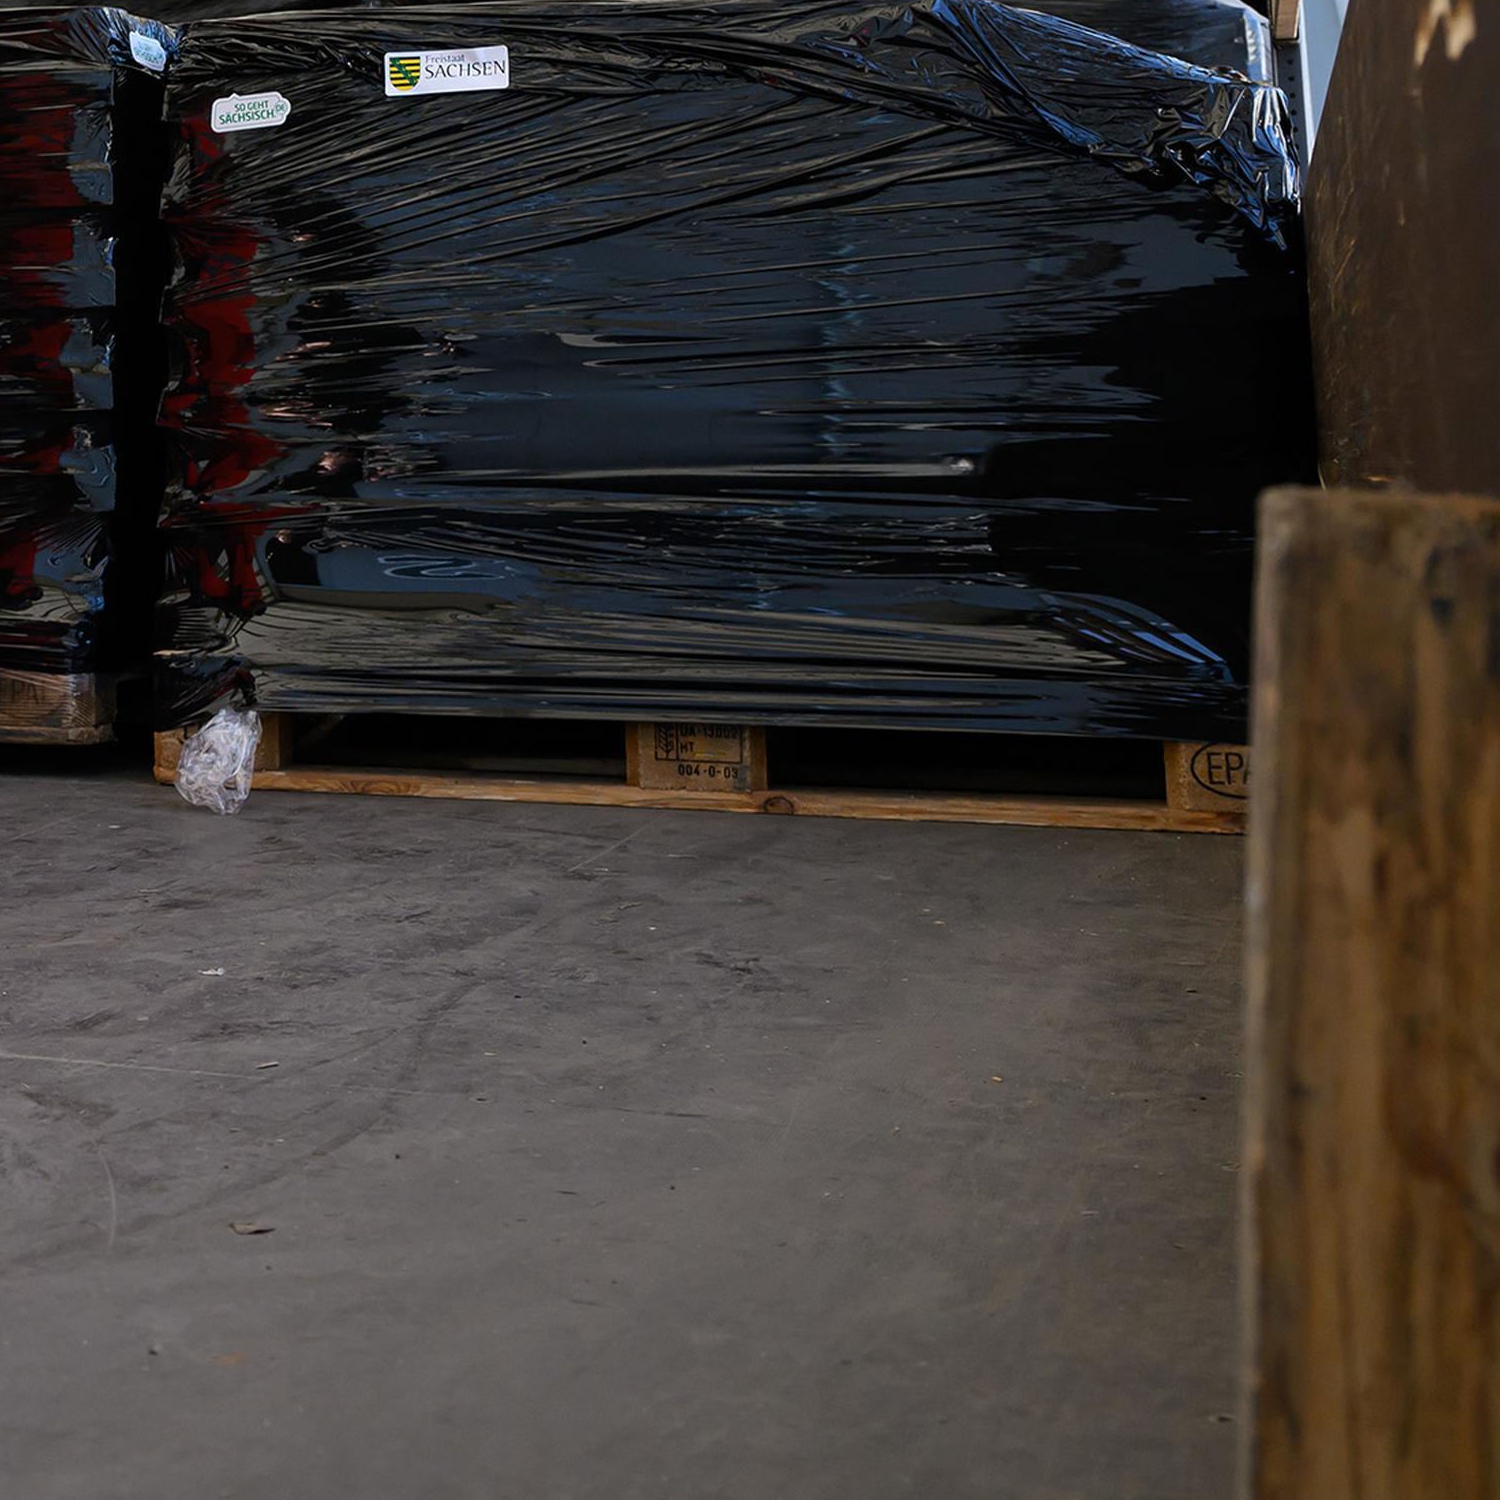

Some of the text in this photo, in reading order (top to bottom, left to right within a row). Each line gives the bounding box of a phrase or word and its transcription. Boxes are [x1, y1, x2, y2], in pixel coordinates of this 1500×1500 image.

[425, 54, 465, 64] Freistaat
[425, 60, 506, 79] SACHSEN
[234, 100, 269, 112] SO GEHT
[680, 741, 694, 753] HT
